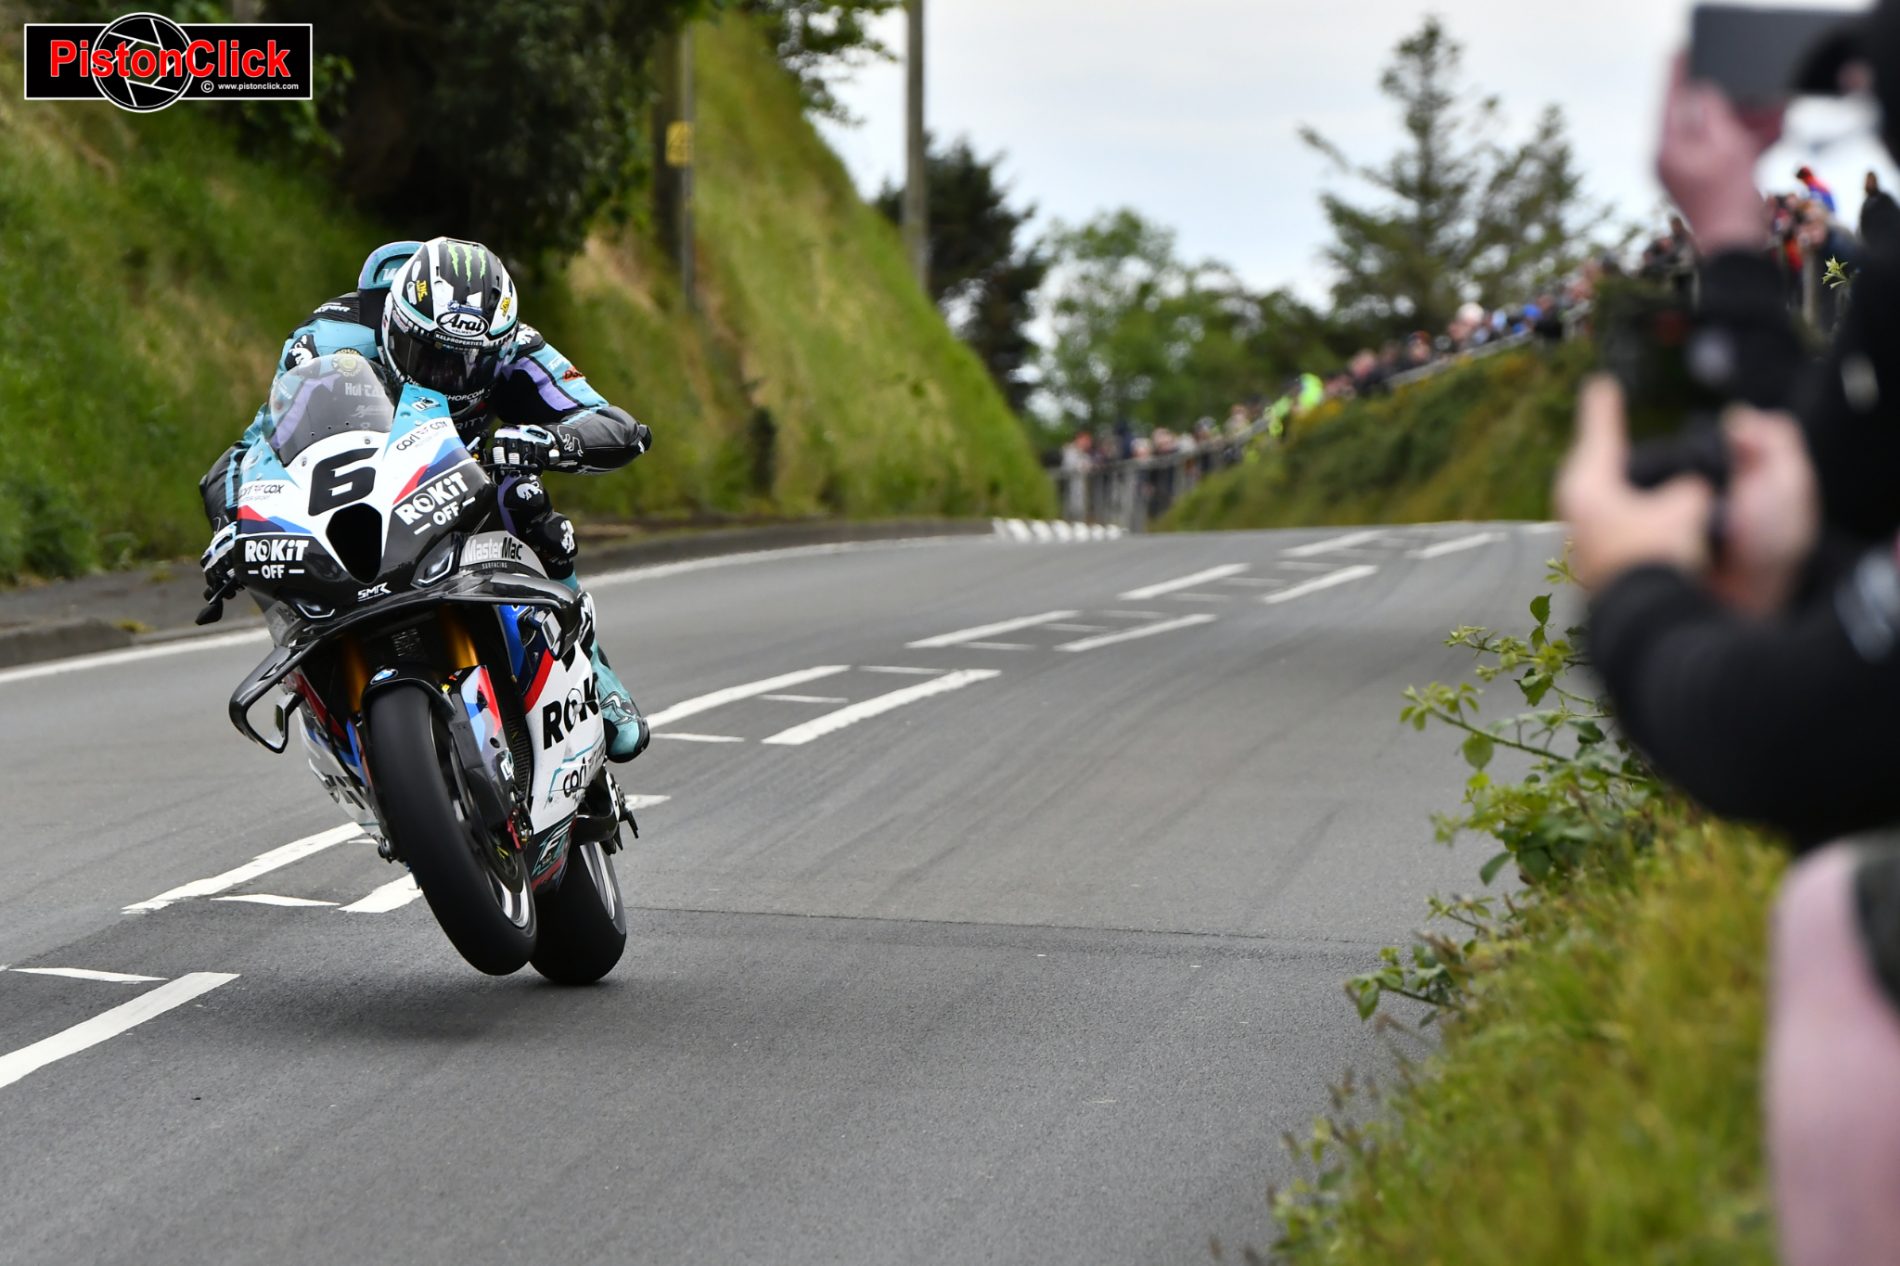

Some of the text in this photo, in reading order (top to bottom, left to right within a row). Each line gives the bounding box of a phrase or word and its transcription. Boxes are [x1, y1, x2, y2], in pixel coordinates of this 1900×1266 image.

[440, 313, 483, 332] Arai
[308, 447, 380, 516] 6
[433, 501, 460, 525] OFF
[464, 537, 523, 562] MasterMac
[261, 564, 285, 579] OFF
[357, 582, 392, 600] SMR
